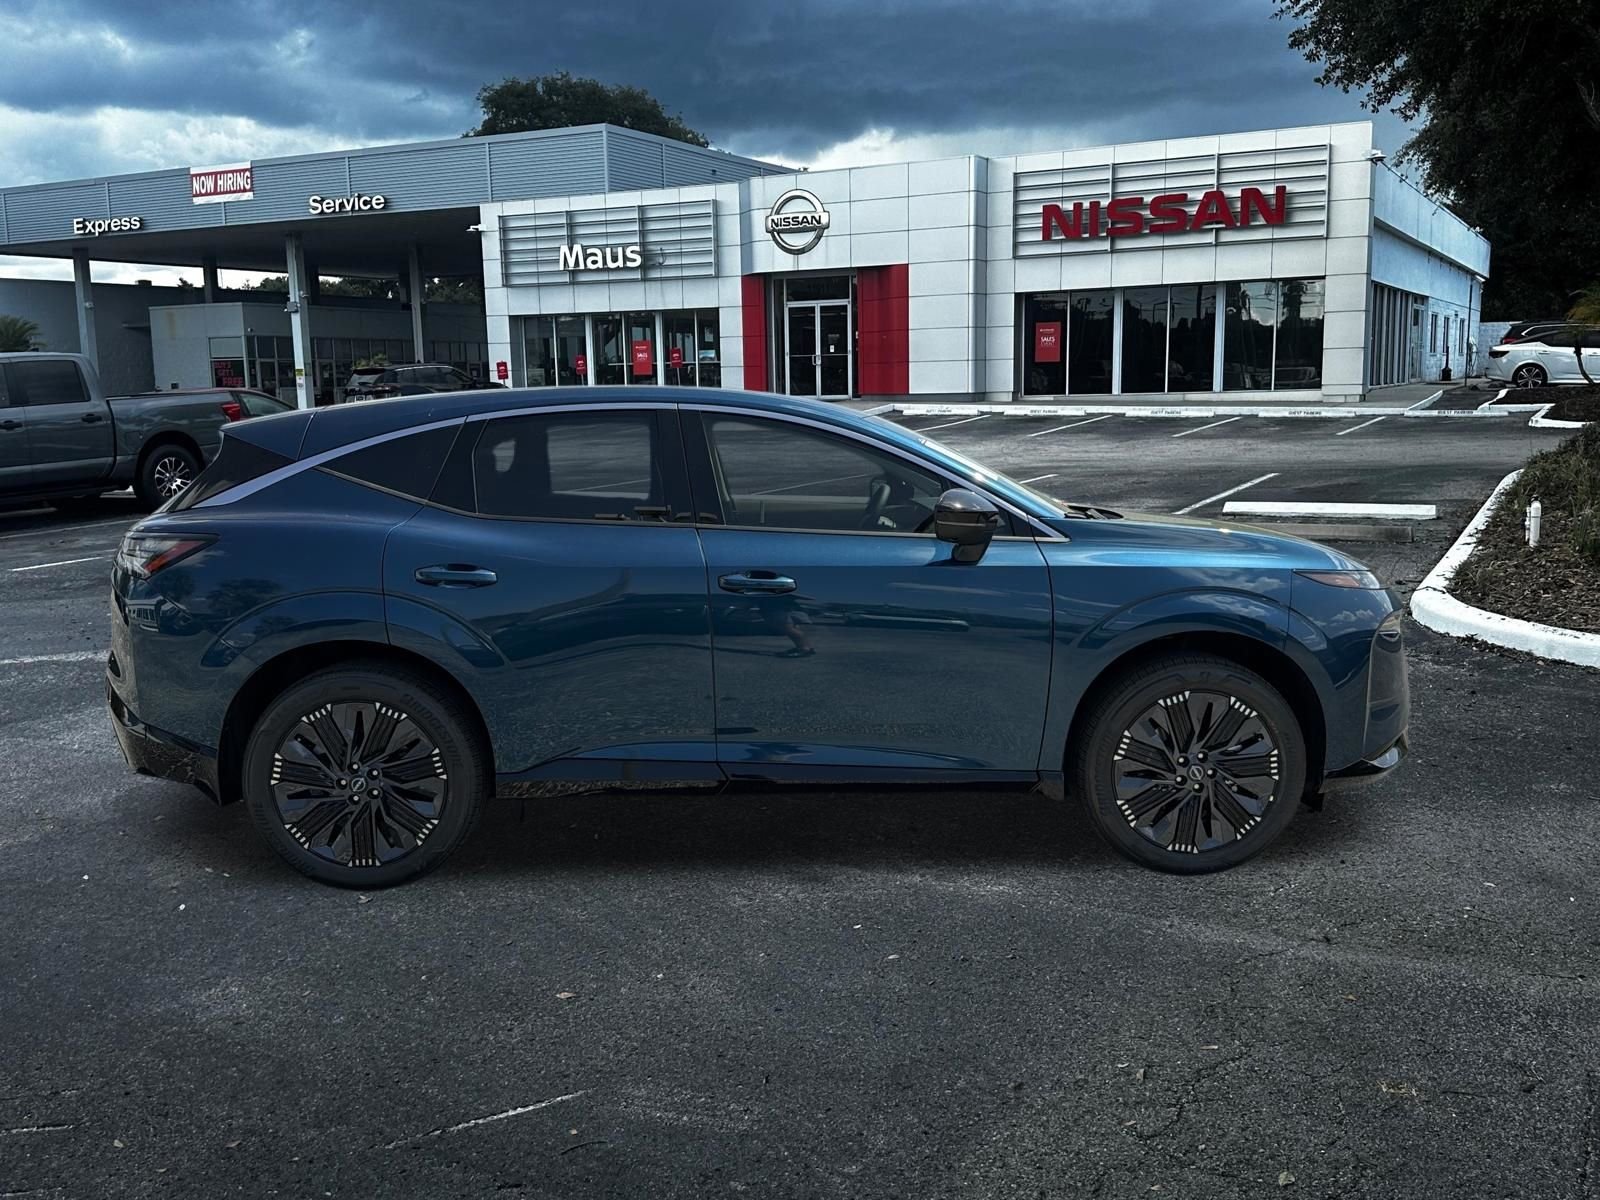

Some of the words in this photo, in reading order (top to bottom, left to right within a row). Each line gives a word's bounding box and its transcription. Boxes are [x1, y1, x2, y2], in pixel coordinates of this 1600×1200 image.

[192, 174, 215, 195] NOW
[217, 170, 251, 192] HIRING
[308, 193, 385, 215] Service
[1041, 185, 1287, 241] NISSAN
[73, 216, 141, 237] Express
[770, 214, 822, 230] NISSAN
[559, 243, 643, 271] Maus
[223, 377, 244, 386] FREE
